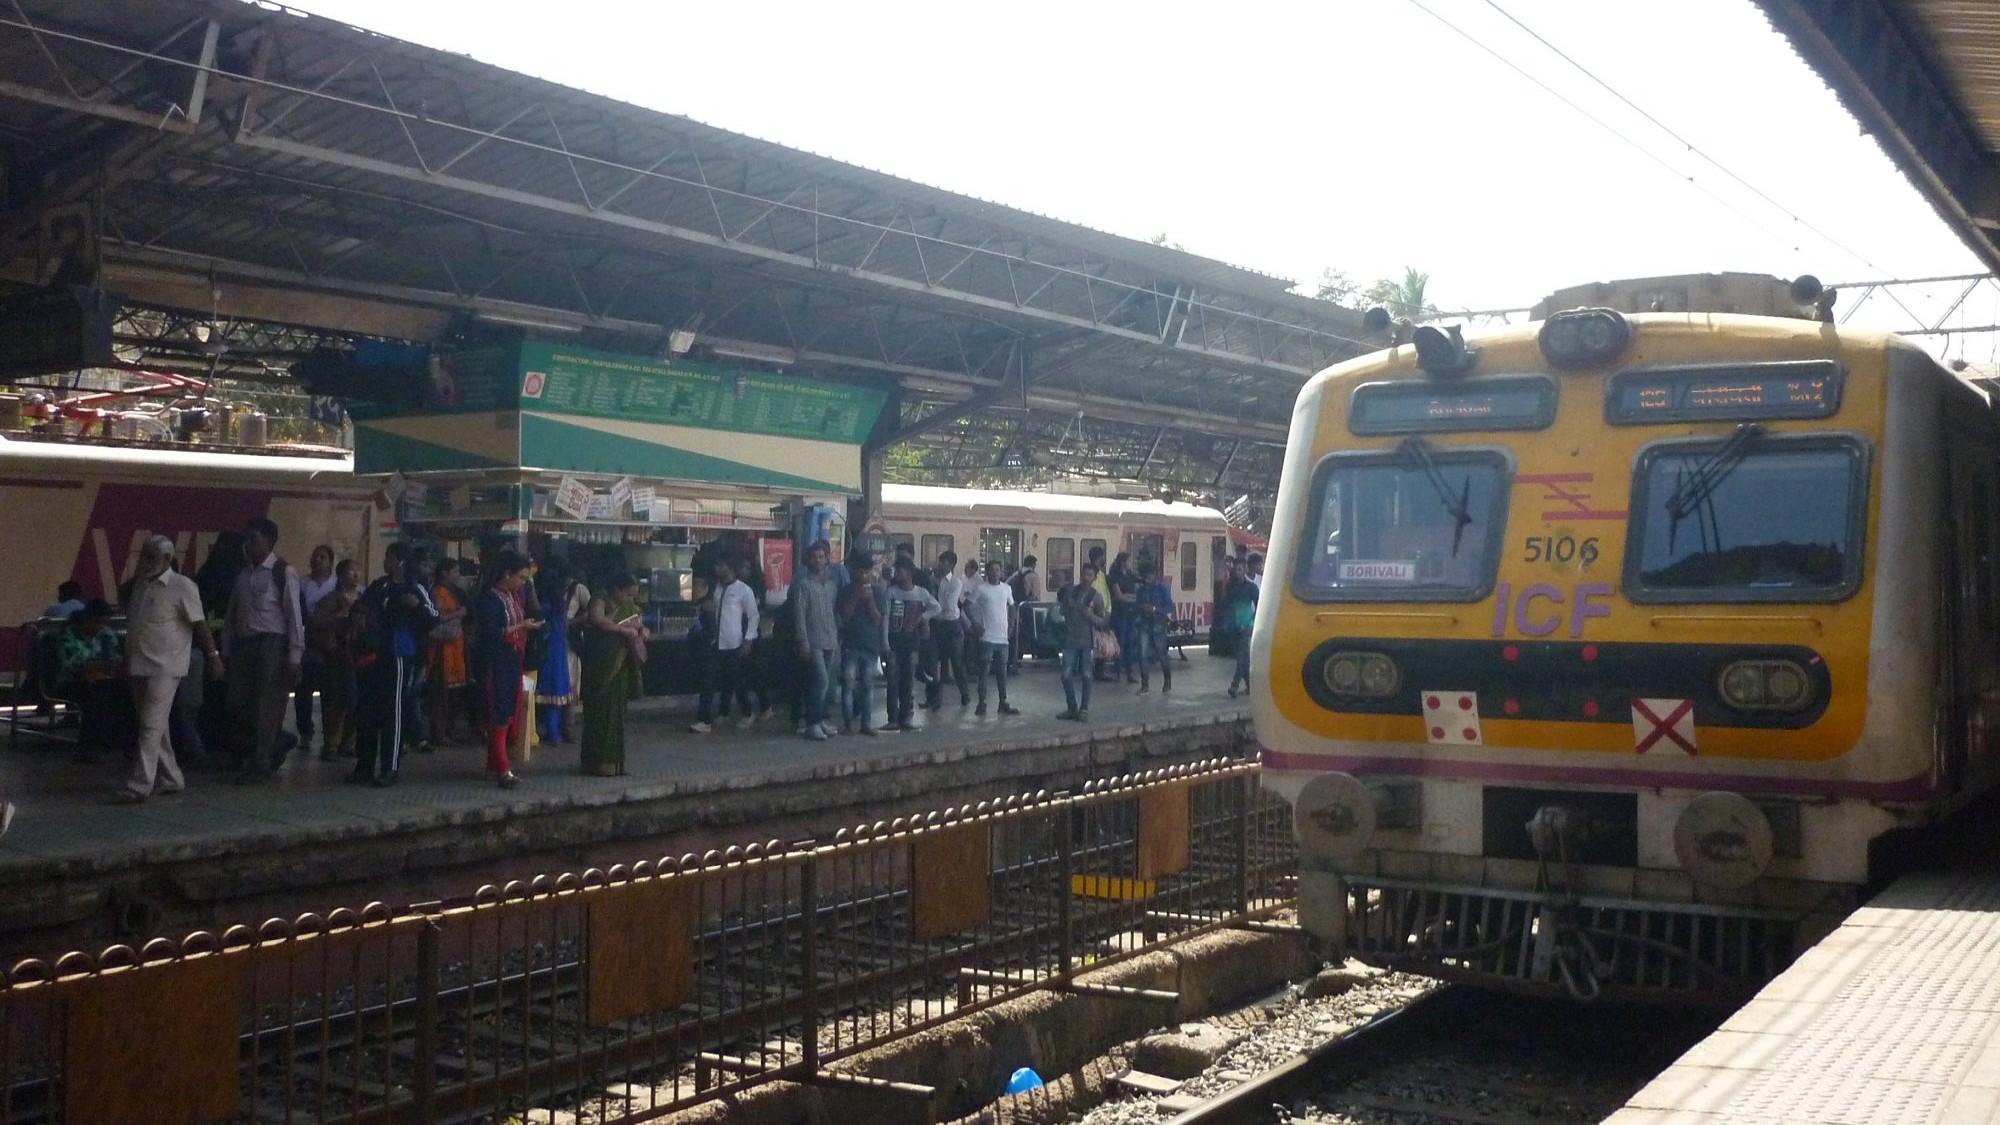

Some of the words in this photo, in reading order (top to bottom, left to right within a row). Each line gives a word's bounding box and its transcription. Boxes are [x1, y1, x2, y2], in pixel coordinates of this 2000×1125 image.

[1524, 536, 1599, 563] 5106
[1346, 566, 1406, 578] BORIVALI
[1491, 582, 1616, 638] ICF
